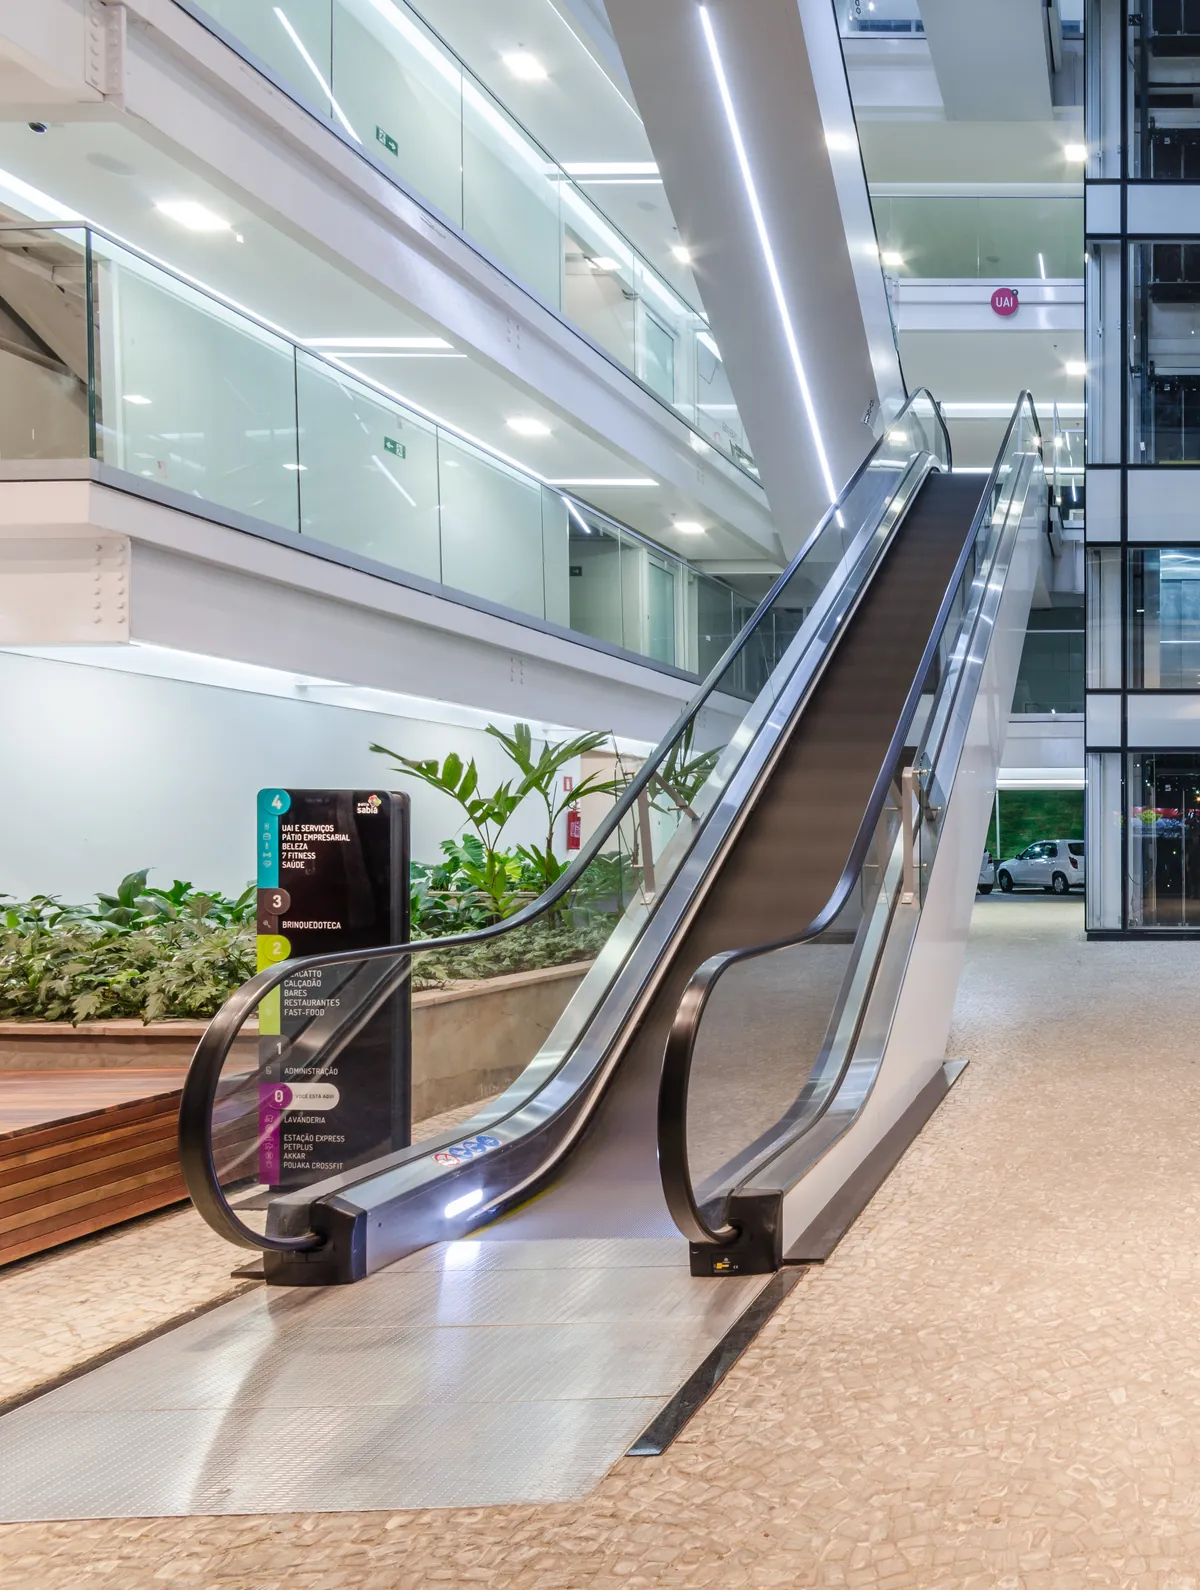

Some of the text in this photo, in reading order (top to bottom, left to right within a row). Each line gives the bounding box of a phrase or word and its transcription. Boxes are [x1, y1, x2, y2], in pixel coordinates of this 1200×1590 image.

[996, 296, 1013, 308] UAI
[272, 794, 282, 810] 4
[301, 824, 334, 832] SERVIÇOS
[282, 833, 302, 841] PÁTIO
[282, 860, 305, 869] SAÚDE
[272, 895, 282, 908] 3
[282, 921, 341, 930] BRINQUEDOTECA
[272, 942, 282, 955] 2
[284, 978, 322, 988] CALÇADÃO
[276, 1042, 282, 1055] 1
[284, 1067, 338, 1077] ADMINISTRAÇÃO
[275, 1090, 283, 1102] 0
[284, 1134, 314, 1143] ESTAÇÃO
